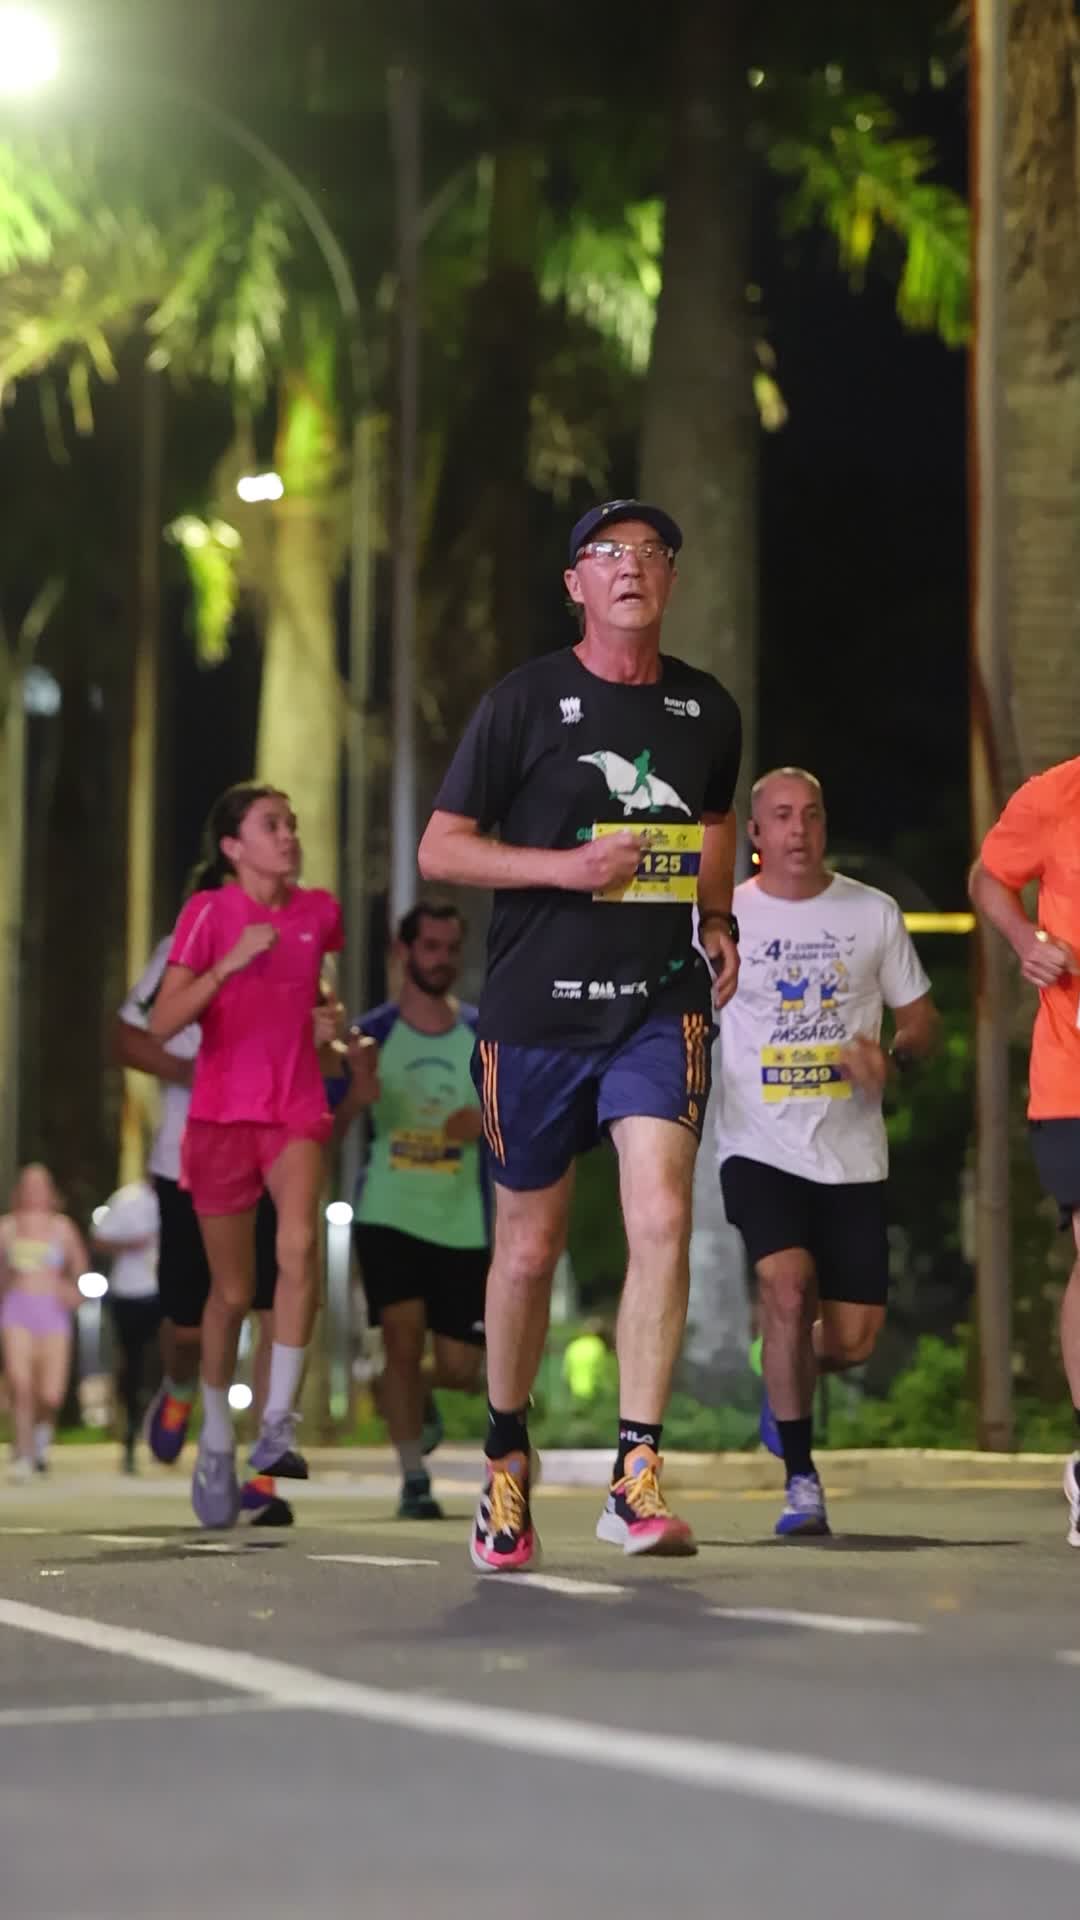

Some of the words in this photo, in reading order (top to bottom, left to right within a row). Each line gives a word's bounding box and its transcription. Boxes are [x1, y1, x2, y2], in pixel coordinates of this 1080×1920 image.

[634, 853, 681, 873] 125
[780, 1067, 832, 1083] 6249
[620, 1429, 655, 1445] FILA
